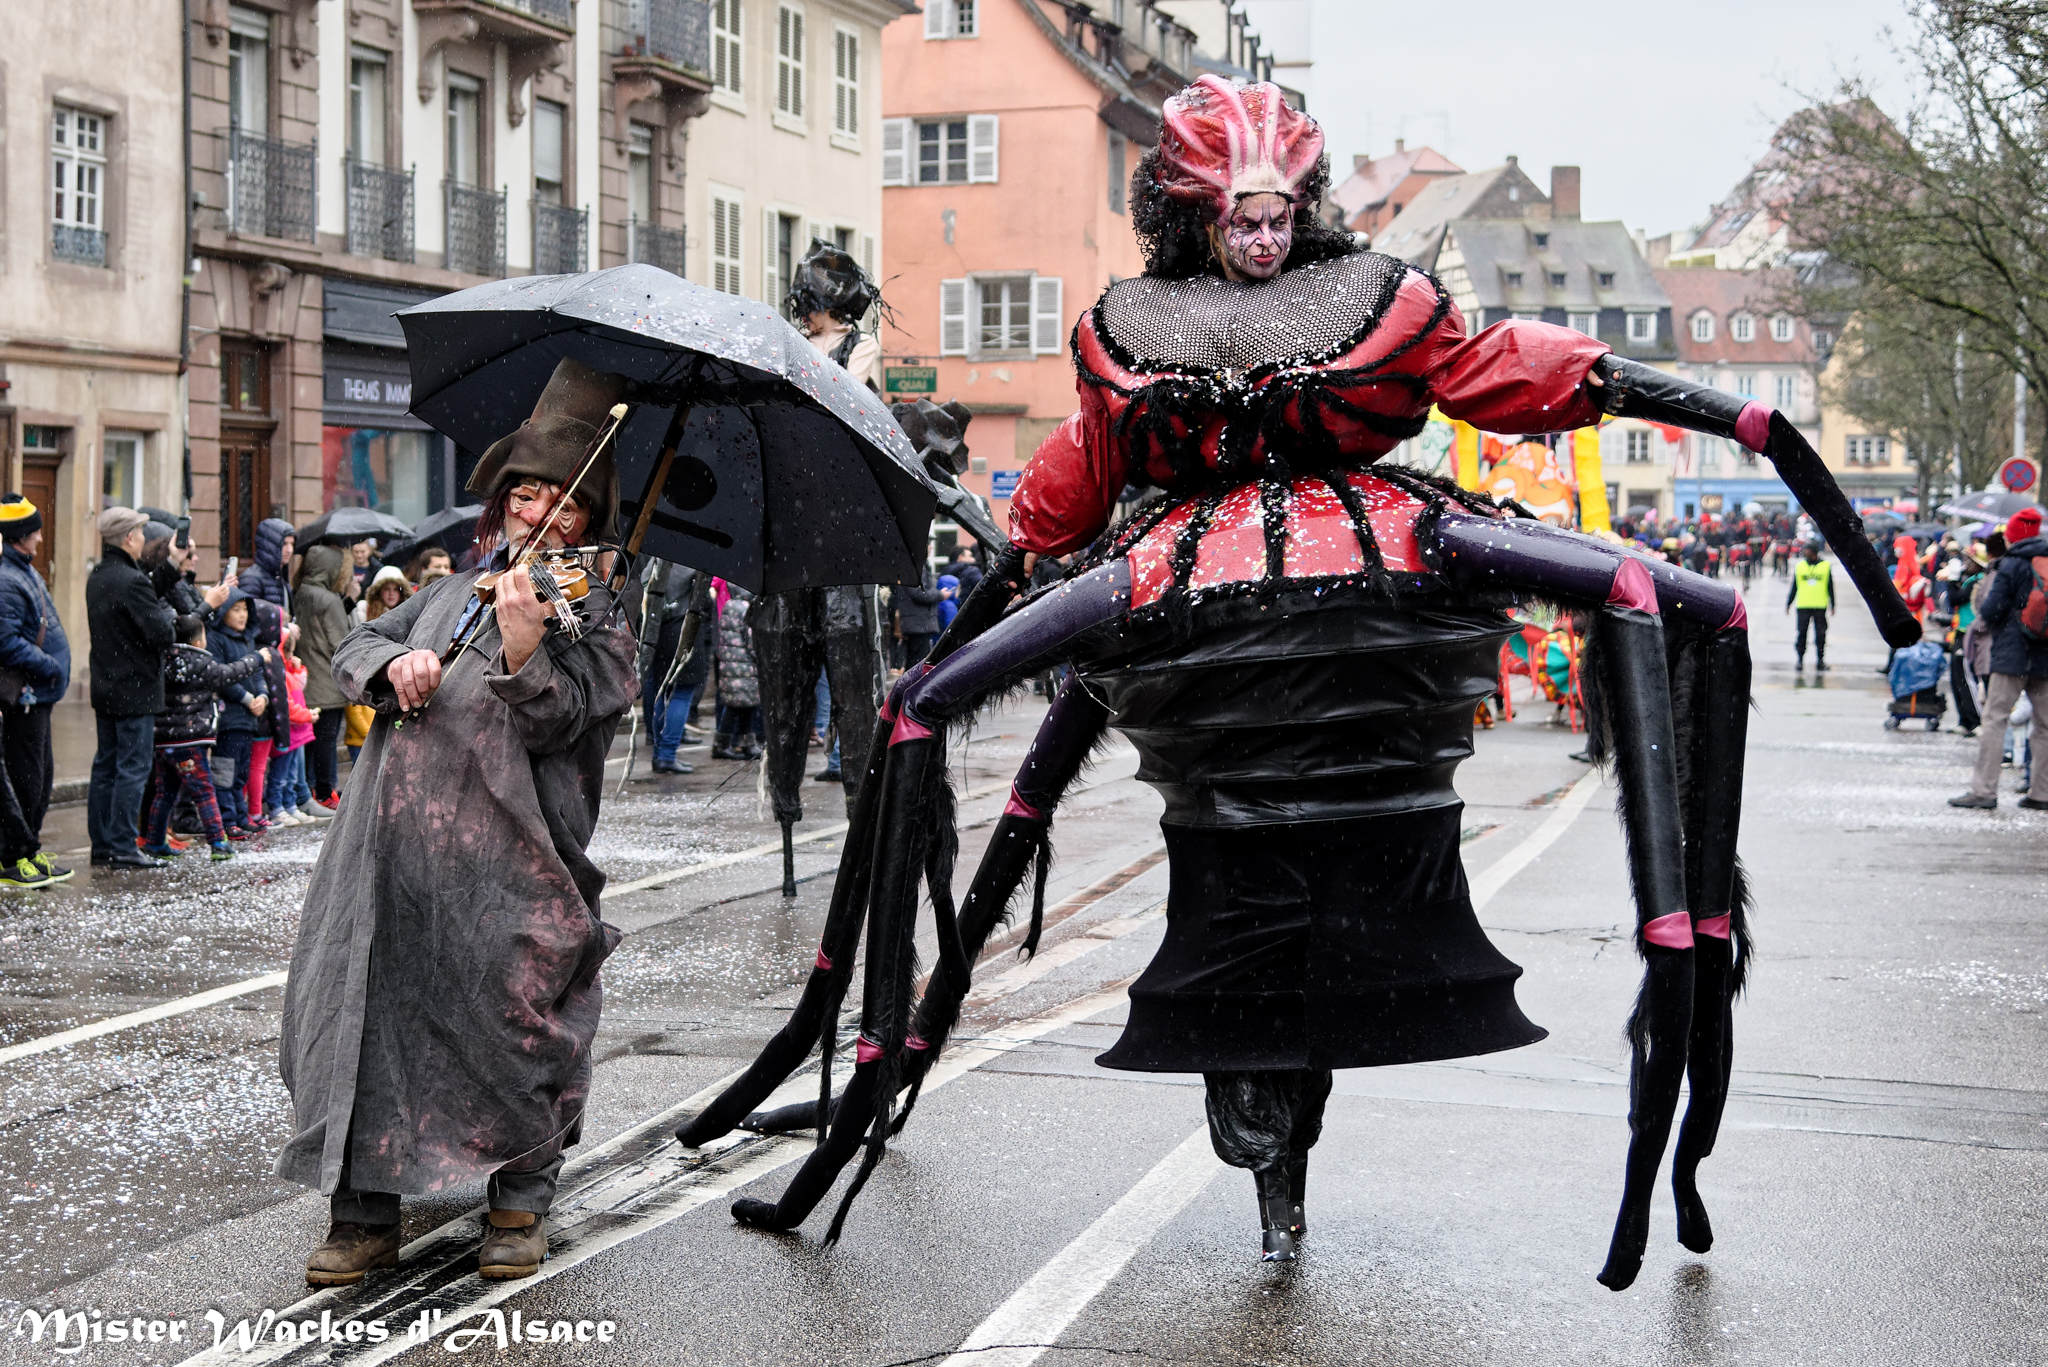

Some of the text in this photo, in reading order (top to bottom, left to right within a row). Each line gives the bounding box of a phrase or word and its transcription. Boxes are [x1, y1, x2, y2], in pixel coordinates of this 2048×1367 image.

[888, 368, 935, 379] BISTROT
[343, 378, 380, 402] THEMIS
[898, 380, 927, 391] QUAI
